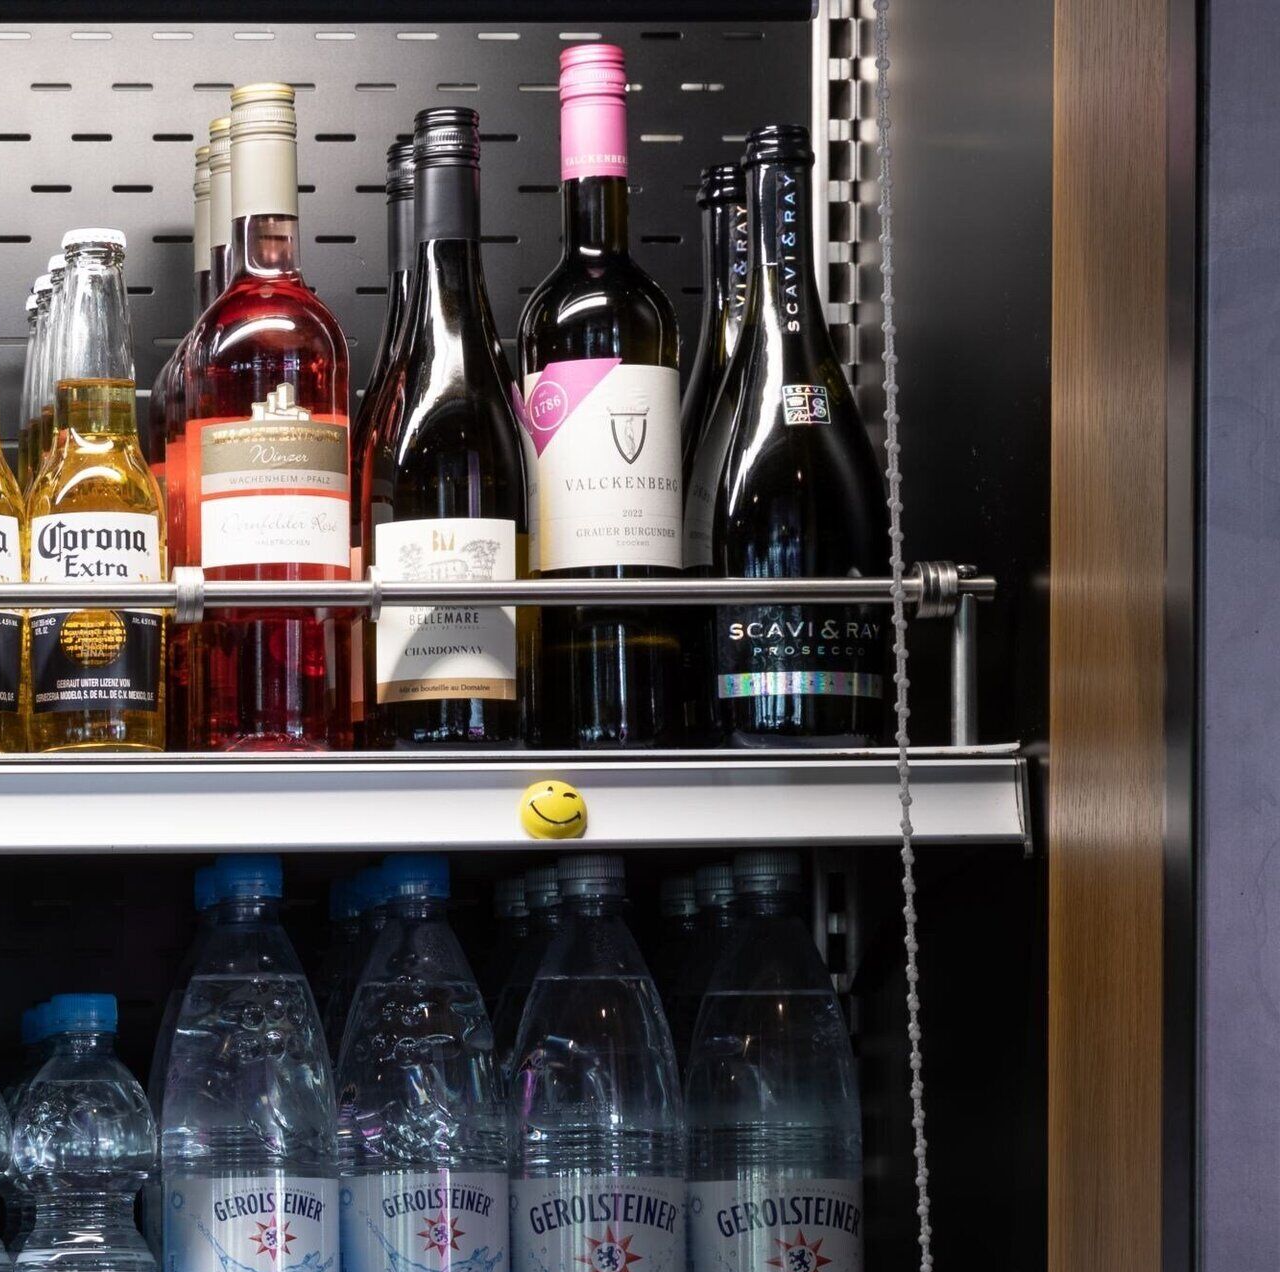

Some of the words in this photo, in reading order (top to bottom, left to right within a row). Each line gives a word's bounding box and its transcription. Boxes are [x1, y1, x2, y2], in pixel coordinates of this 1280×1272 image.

[534, 397, 562, 419] 1786
[250, 444, 310, 464] Winzer
[229, 475, 298, 485] WACHENHEIM
[307, 475, 331, 485] PFALZ
[565, 476, 679, 493] VALCKENBERG
[38, 522, 147, 562] Corona
[576, 527, 620, 539] GRAUER
[624, 527, 676, 539] BURGUNDER
[65, 555, 129, 578] Extra
[409, 612, 479, 625] BELLEMARE
[729, 621, 813, 641] SCAVI
[821, 619, 839, 640] &
[846, 622, 880, 640] RAY
[404, 645, 484, 656] CHARDONNAY
[753, 646, 865, 657] PROSECCO
[214, 1192, 323, 1223] GEROLSTEINER
[382, 1188, 491, 1219] GEROLSTEINER
[529, 1193, 678, 1235] GEROLSTEINER
[717, 1196, 860, 1238] GEROLSTEINER
